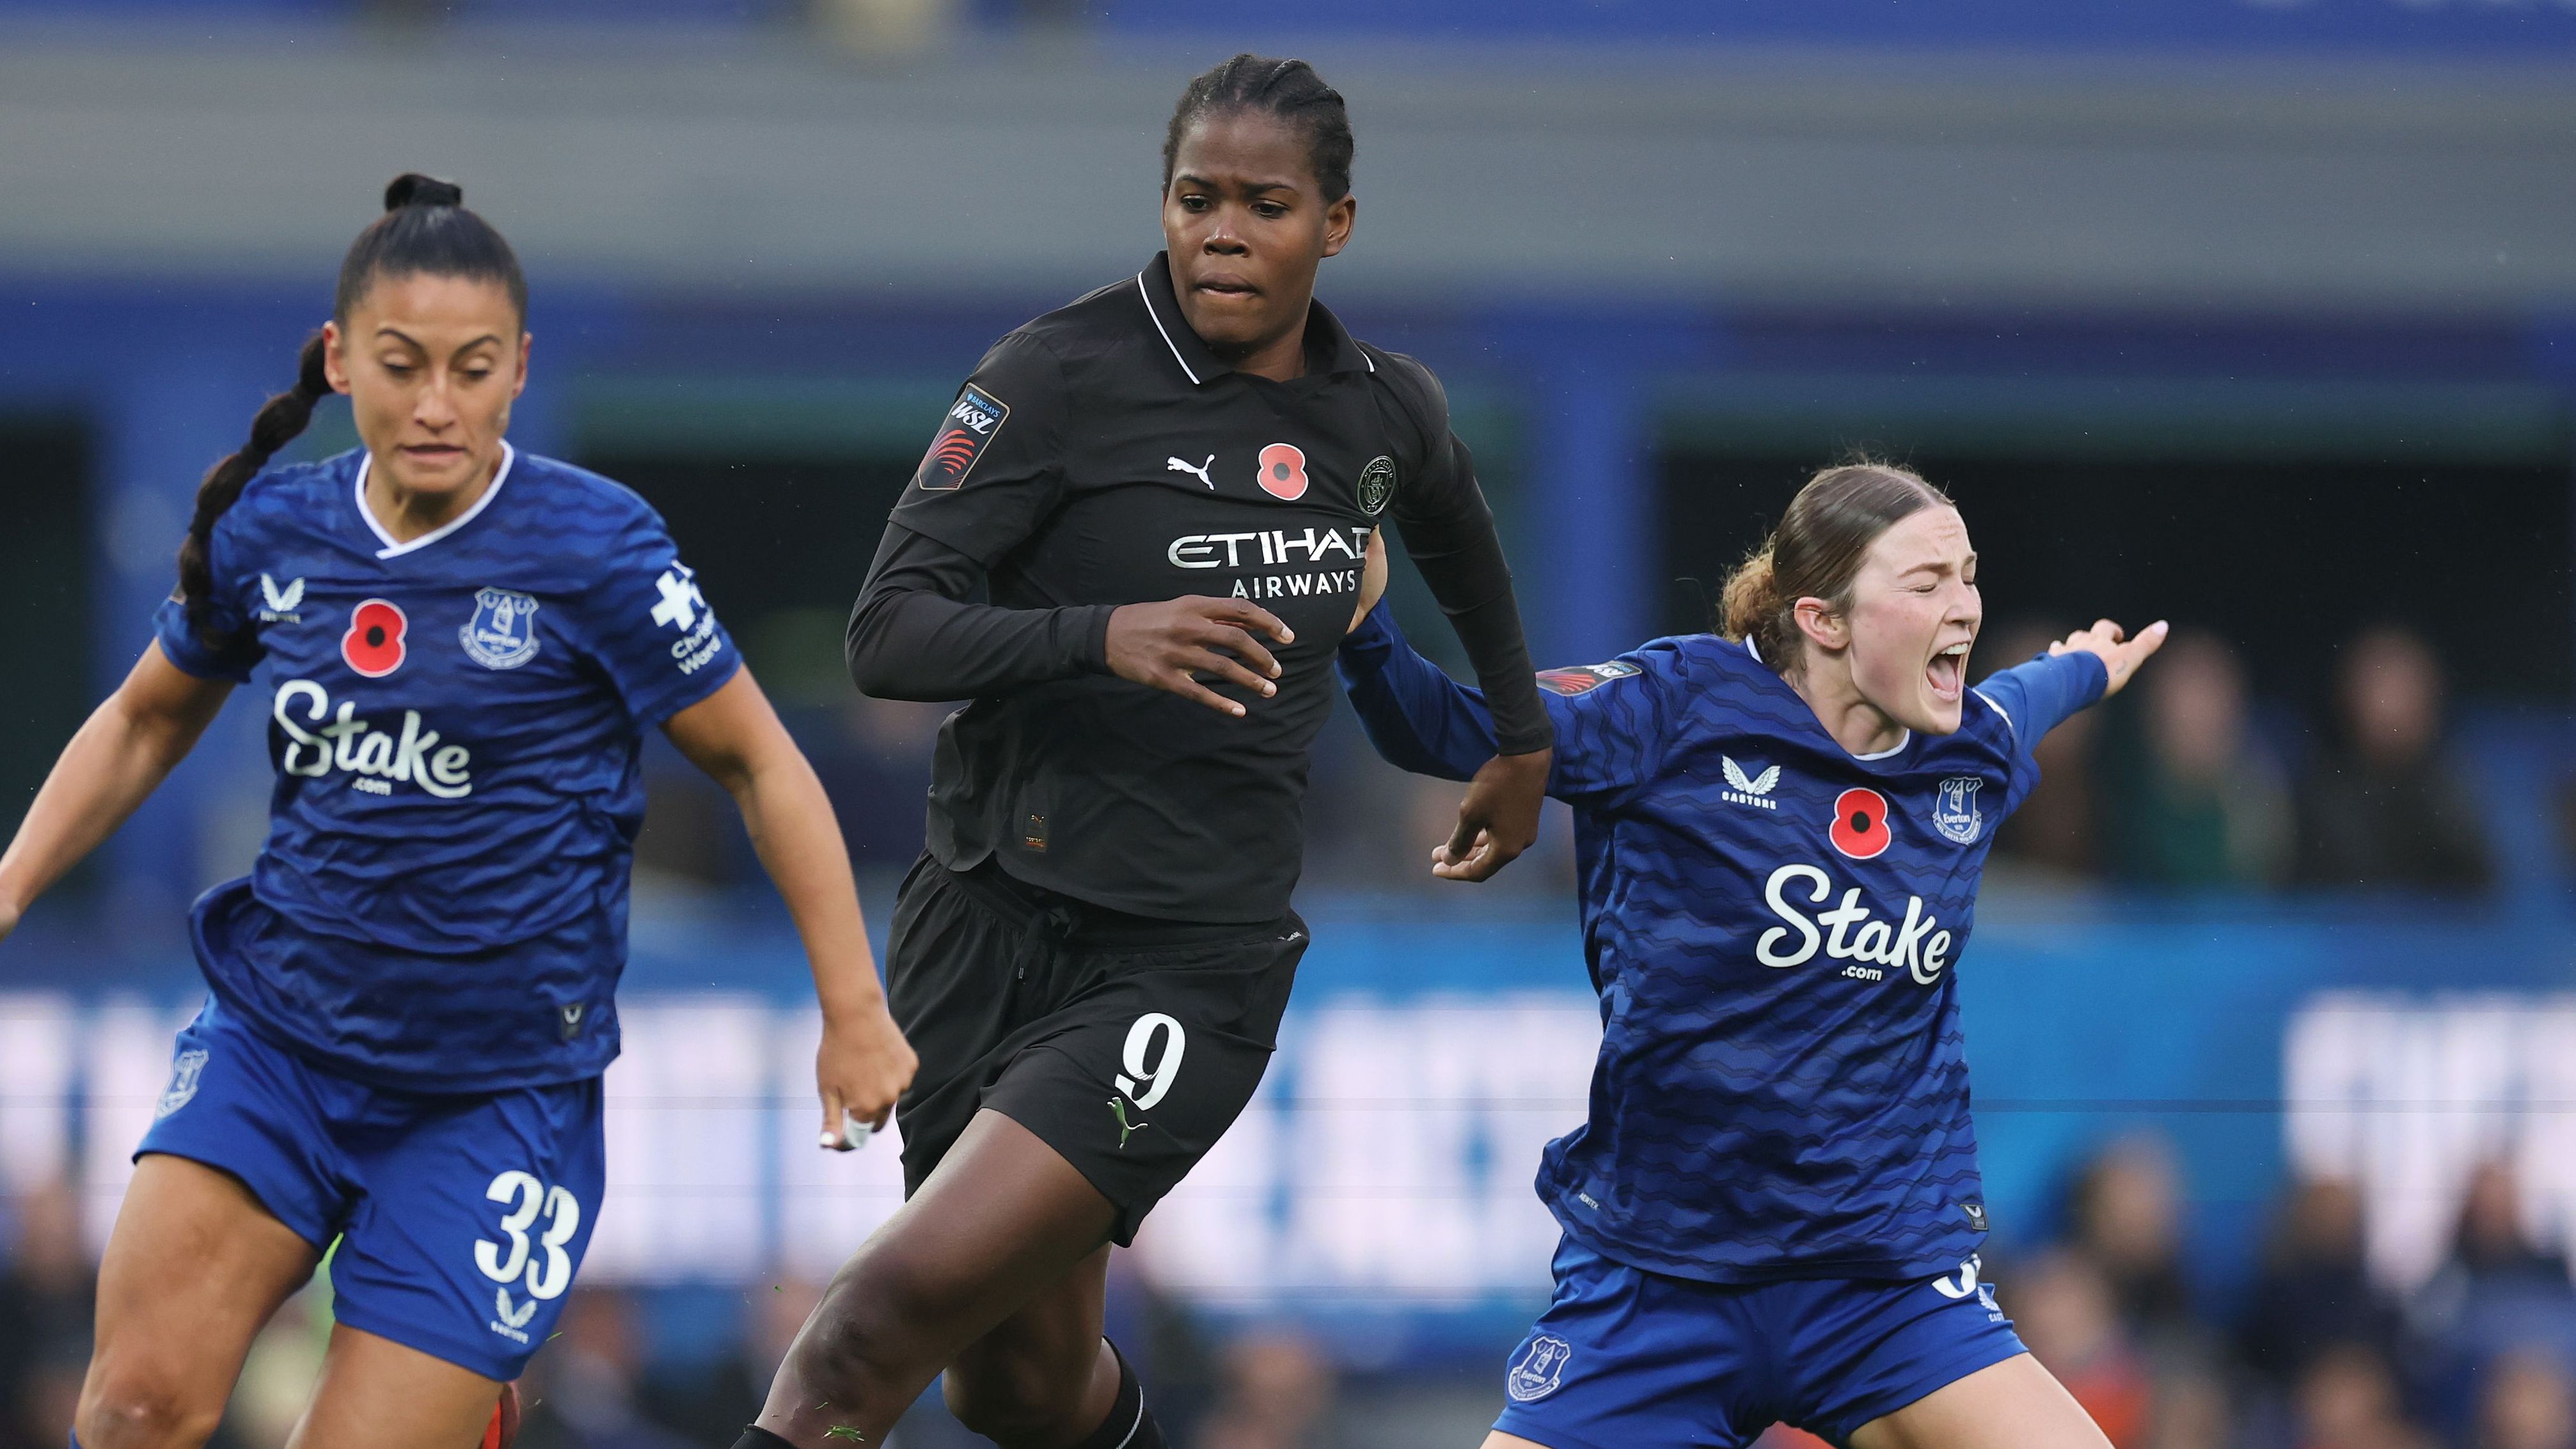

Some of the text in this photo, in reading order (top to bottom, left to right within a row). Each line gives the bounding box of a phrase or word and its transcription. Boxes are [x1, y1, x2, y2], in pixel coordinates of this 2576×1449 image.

[951, 402, 995, 435] WSL
[972, 396, 1000, 418] BARCLAYS
[1231, 570, 1355, 599] AIRWAYS
[274, 679, 473, 798] Stake
[1721, 791, 1776, 810] CASTORE
[1943, 812, 1971, 824] Everton
[1756, 864, 1951, 985] Stake
[1841, 965, 1883, 981] .com
[1115, 1012, 1186, 1111] 9
[474, 1170, 580, 1301] 33
[1520, 1370, 1546, 1384] Everton
